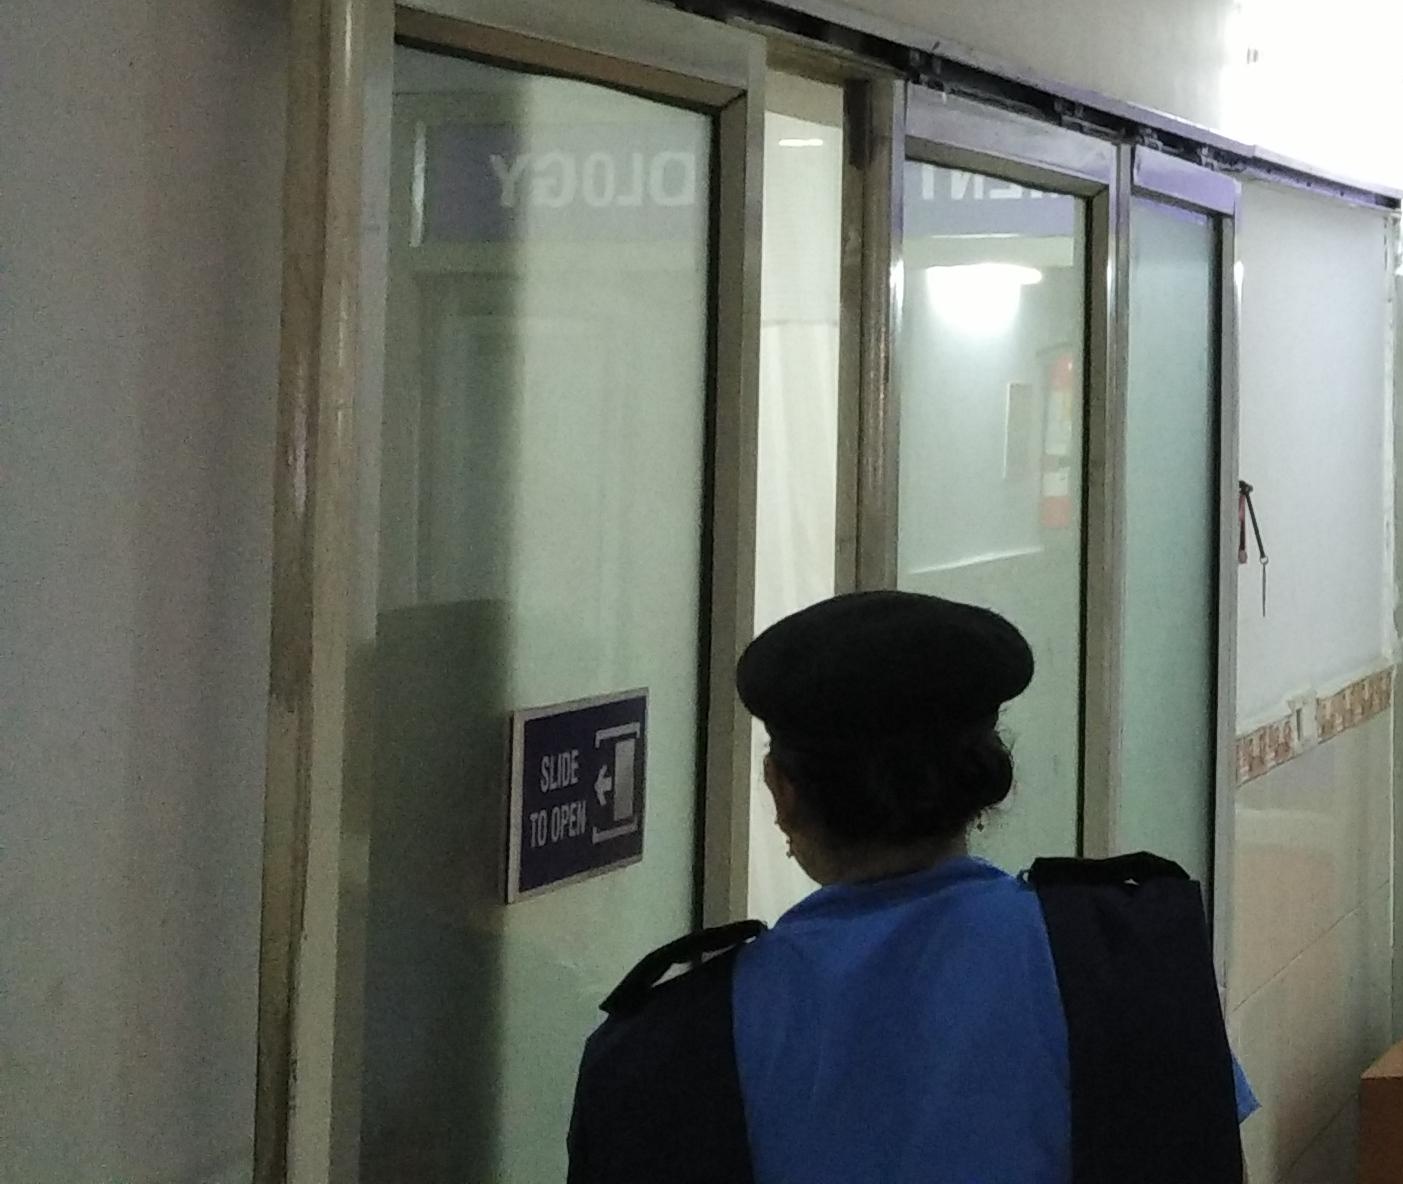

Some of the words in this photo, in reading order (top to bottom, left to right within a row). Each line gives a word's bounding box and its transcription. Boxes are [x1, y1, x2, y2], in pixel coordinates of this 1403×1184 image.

[540, 749, 579, 793] SLIDE
[530, 809, 548, 848] TO
[550, 800, 587, 843] OPEN
